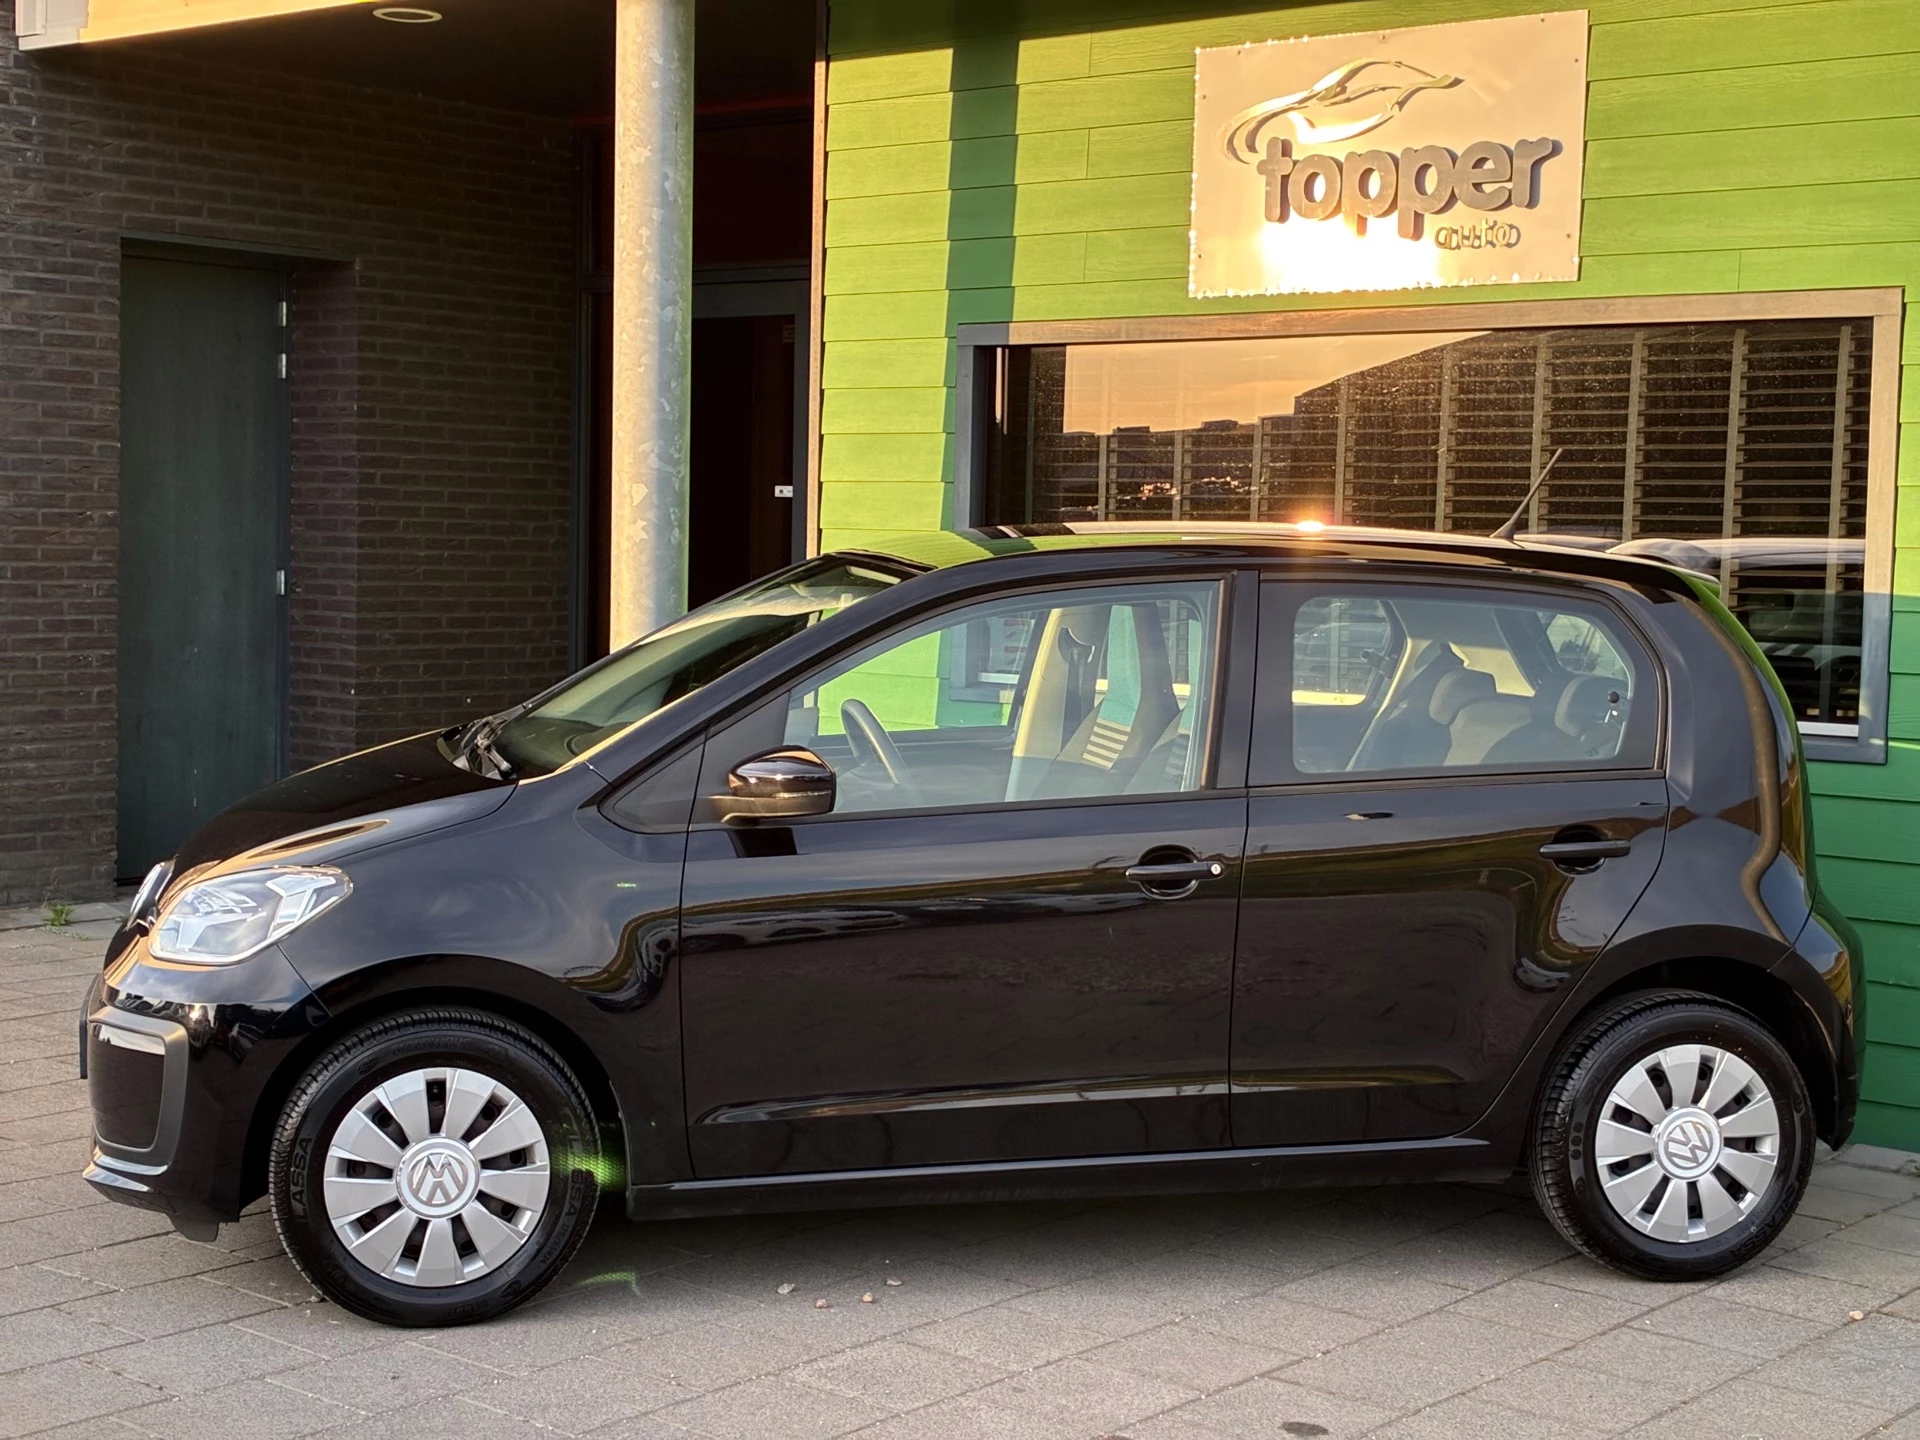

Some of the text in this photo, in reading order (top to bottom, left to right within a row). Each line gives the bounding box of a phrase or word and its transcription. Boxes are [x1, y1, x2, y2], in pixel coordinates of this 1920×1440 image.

[1257, 137, 1557, 241] topper
[1435, 217, 1514, 249] auto
[289, 1137, 313, 1222] LASSA
